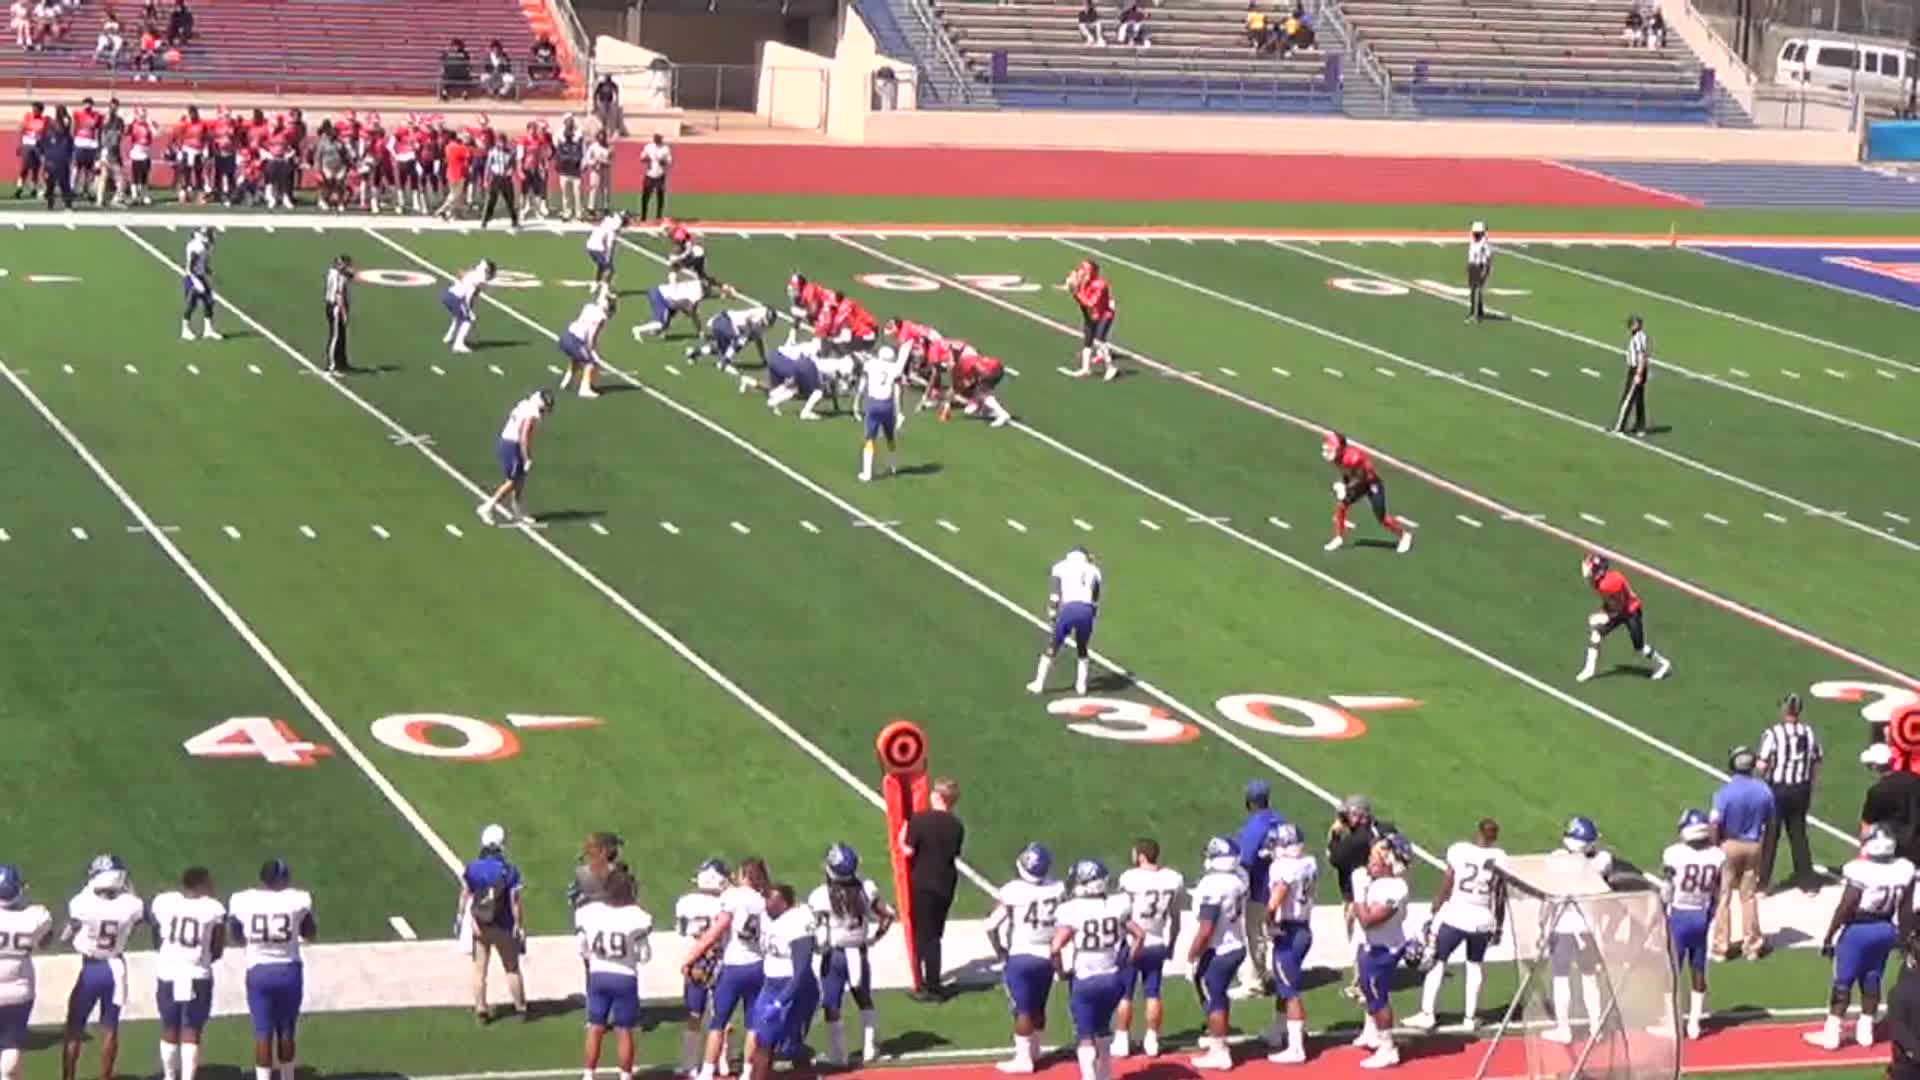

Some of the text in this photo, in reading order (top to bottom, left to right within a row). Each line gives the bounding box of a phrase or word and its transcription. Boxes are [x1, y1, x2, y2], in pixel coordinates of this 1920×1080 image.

[1047, 693, 1367, 743] 30
[183, 712, 523, 766] 40
[1680, 863, 1718, 892] 80
[1023, 897, 1058, 929] 43
[1140, 889, 1176, 920] 37
[169, 915, 201, 948] 10
[250, 913, 294, 944] 93
[1081, 916, 1121, 950] 89
[591, 930, 627, 960] 49
